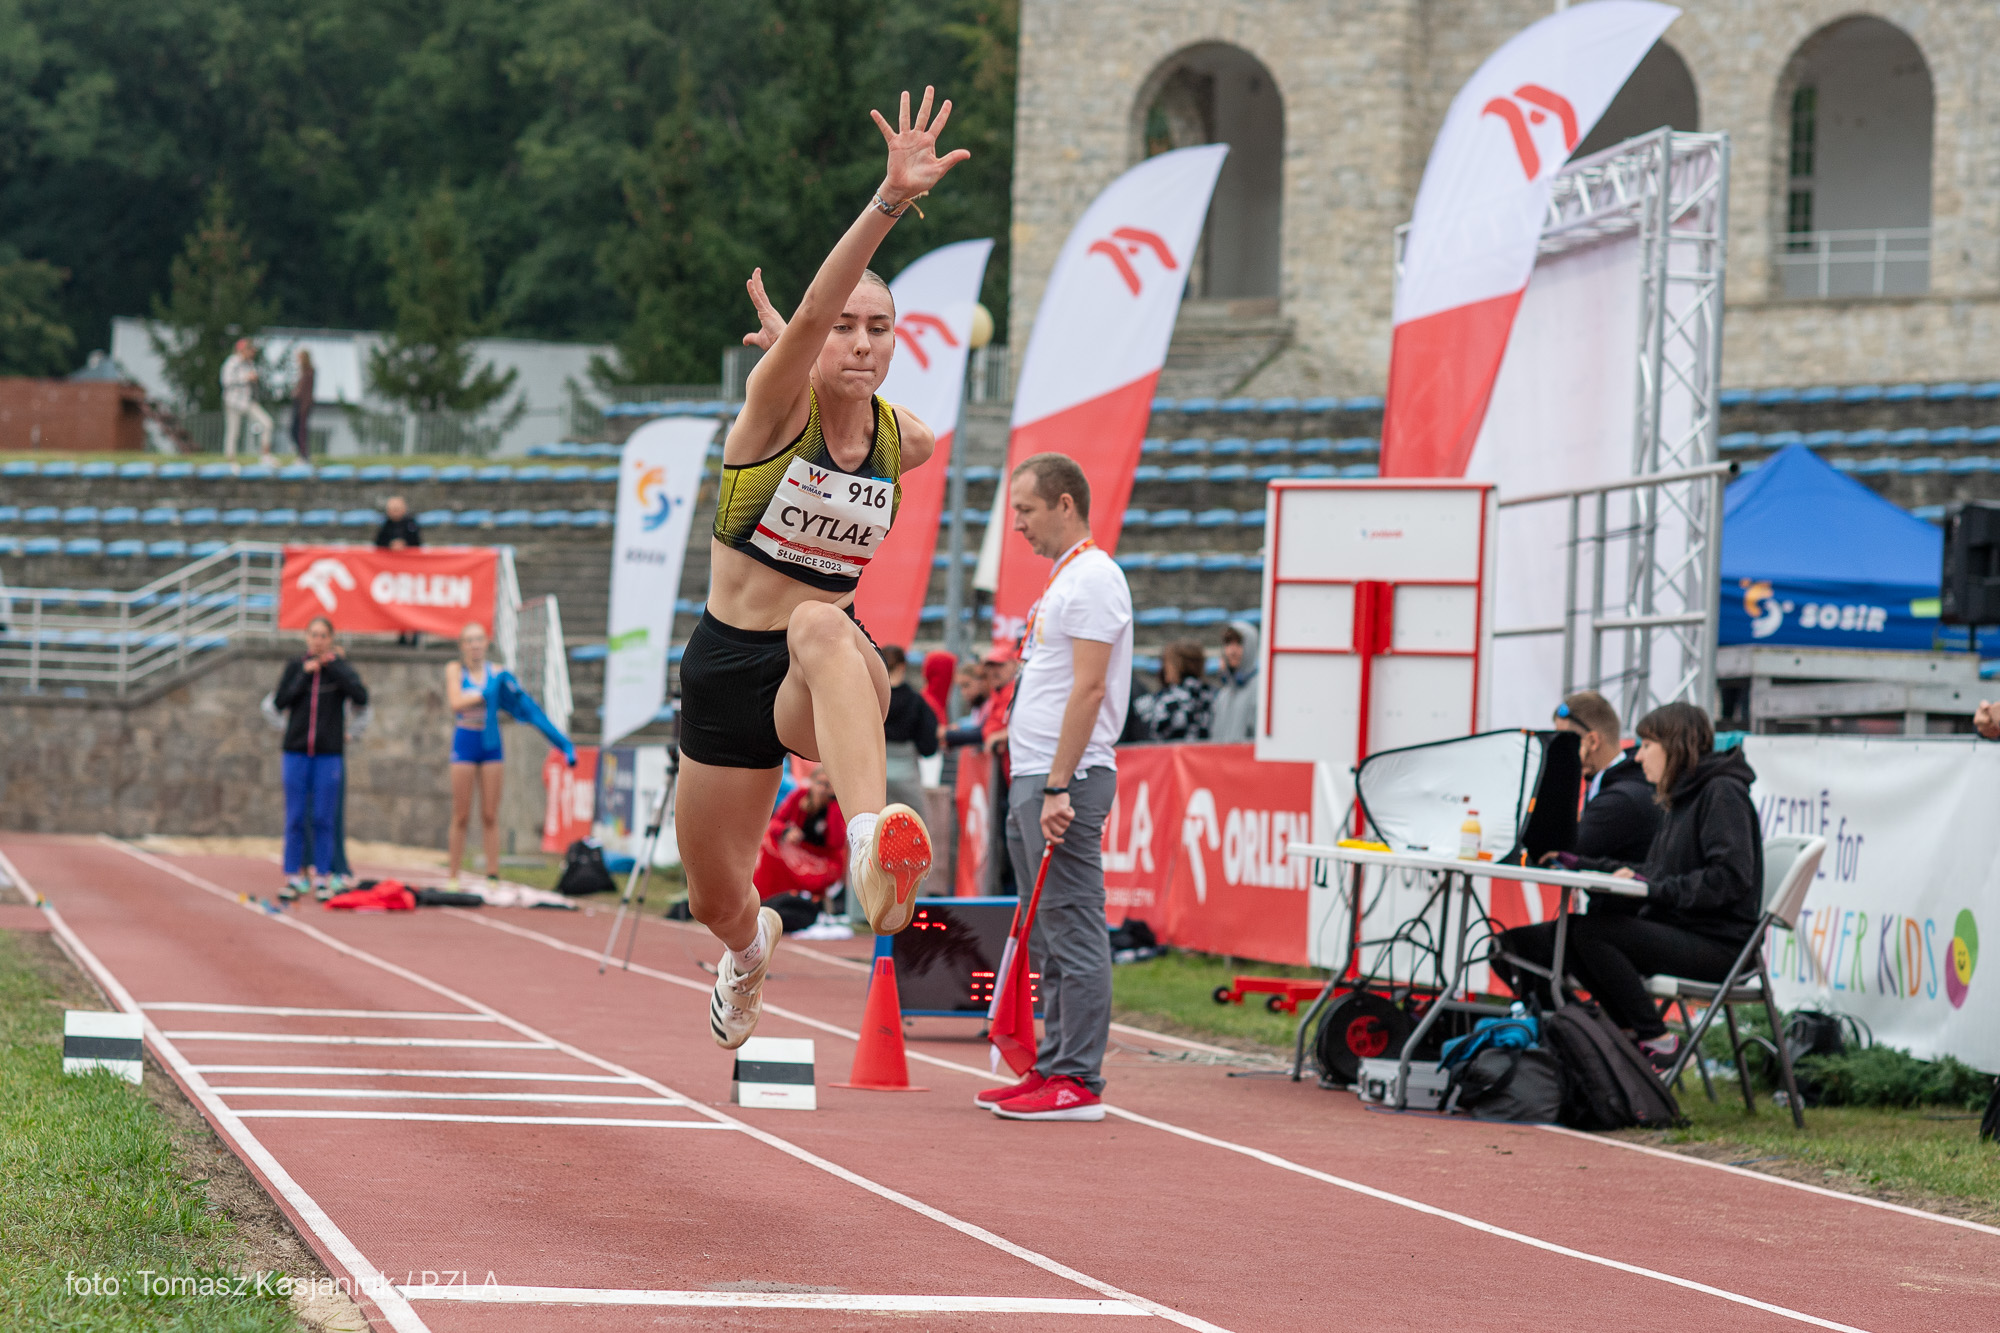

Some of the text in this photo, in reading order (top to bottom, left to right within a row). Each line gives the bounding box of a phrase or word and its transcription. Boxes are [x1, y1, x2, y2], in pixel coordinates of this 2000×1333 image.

[801, 484, 822, 496] WIMAR
[849, 482, 887, 509] 916
[780, 506, 873, 547] CYTLAŁ
[777, 549, 818, 567] SŁUBICE
[819, 560, 842, 572] 2023
[370, 570, 472, 608] ORLEN
[1222, 807, 1310, 891] ORLEN
[1835, 816, 1863, 882] for
[1877, 912, 1938, 1000] KIDS
